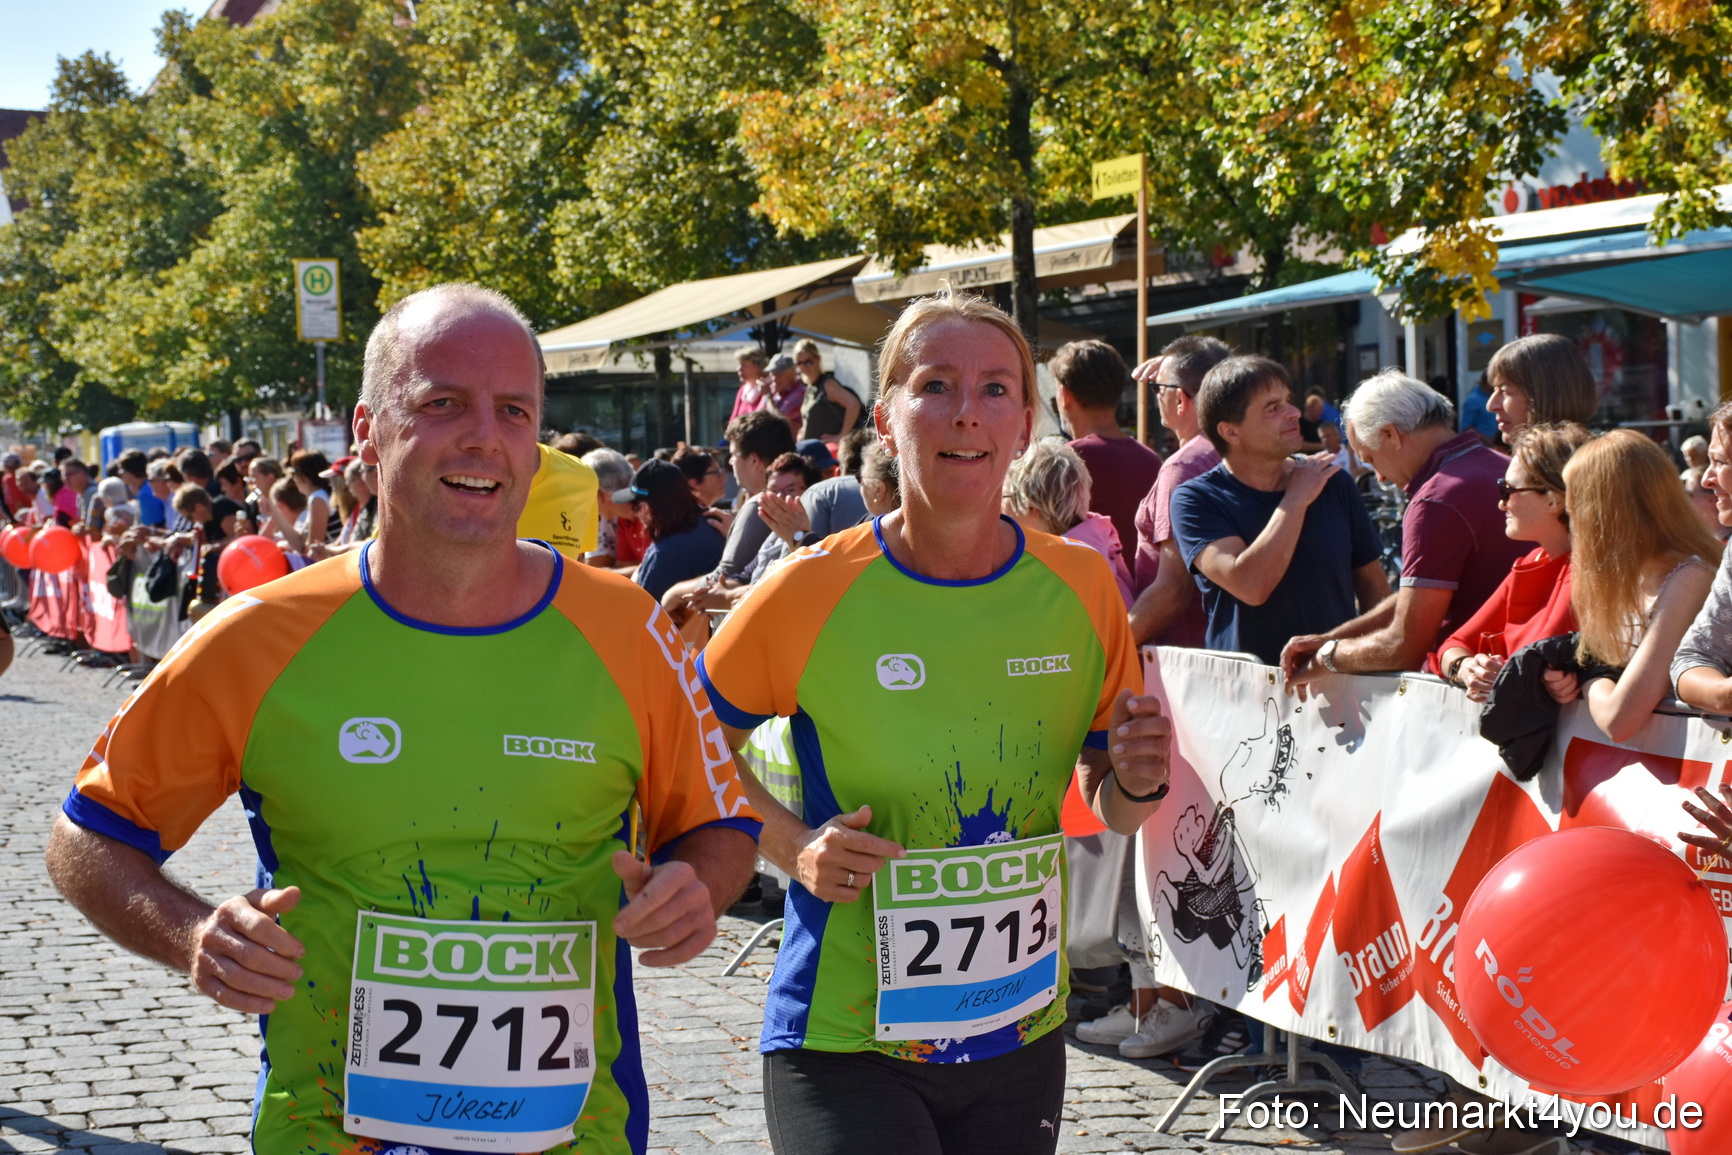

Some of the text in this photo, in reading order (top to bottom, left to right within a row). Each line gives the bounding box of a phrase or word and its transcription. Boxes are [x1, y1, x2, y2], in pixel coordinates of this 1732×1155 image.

[1102, 169, 1138, 187] Toiletten
[1538, 168, 1646, 210] vodafo
[1007, 654, 1072, 676] BOCK
[503, 734, 596, 763] BOCK
[890, 843, 1062, 902] BOCK
[374, 925, 579, 983] BOCK
[904, 897, 1047, 977] 2713
[1339, 921, 1408, 998] Braun
[955, 976, 1027, 1012] KERSTIN
[1380, 975, 1400, 996] Sicher
[1436, 980, 1459, 1013] Sicher
[1474, 937, 1581, 1066] RÖDL
[378, 999, 571, 1072] 2712
[1513, 1019, 1572, 1071] energie
[416, 1090, 526, 1123] JÜRGEN
